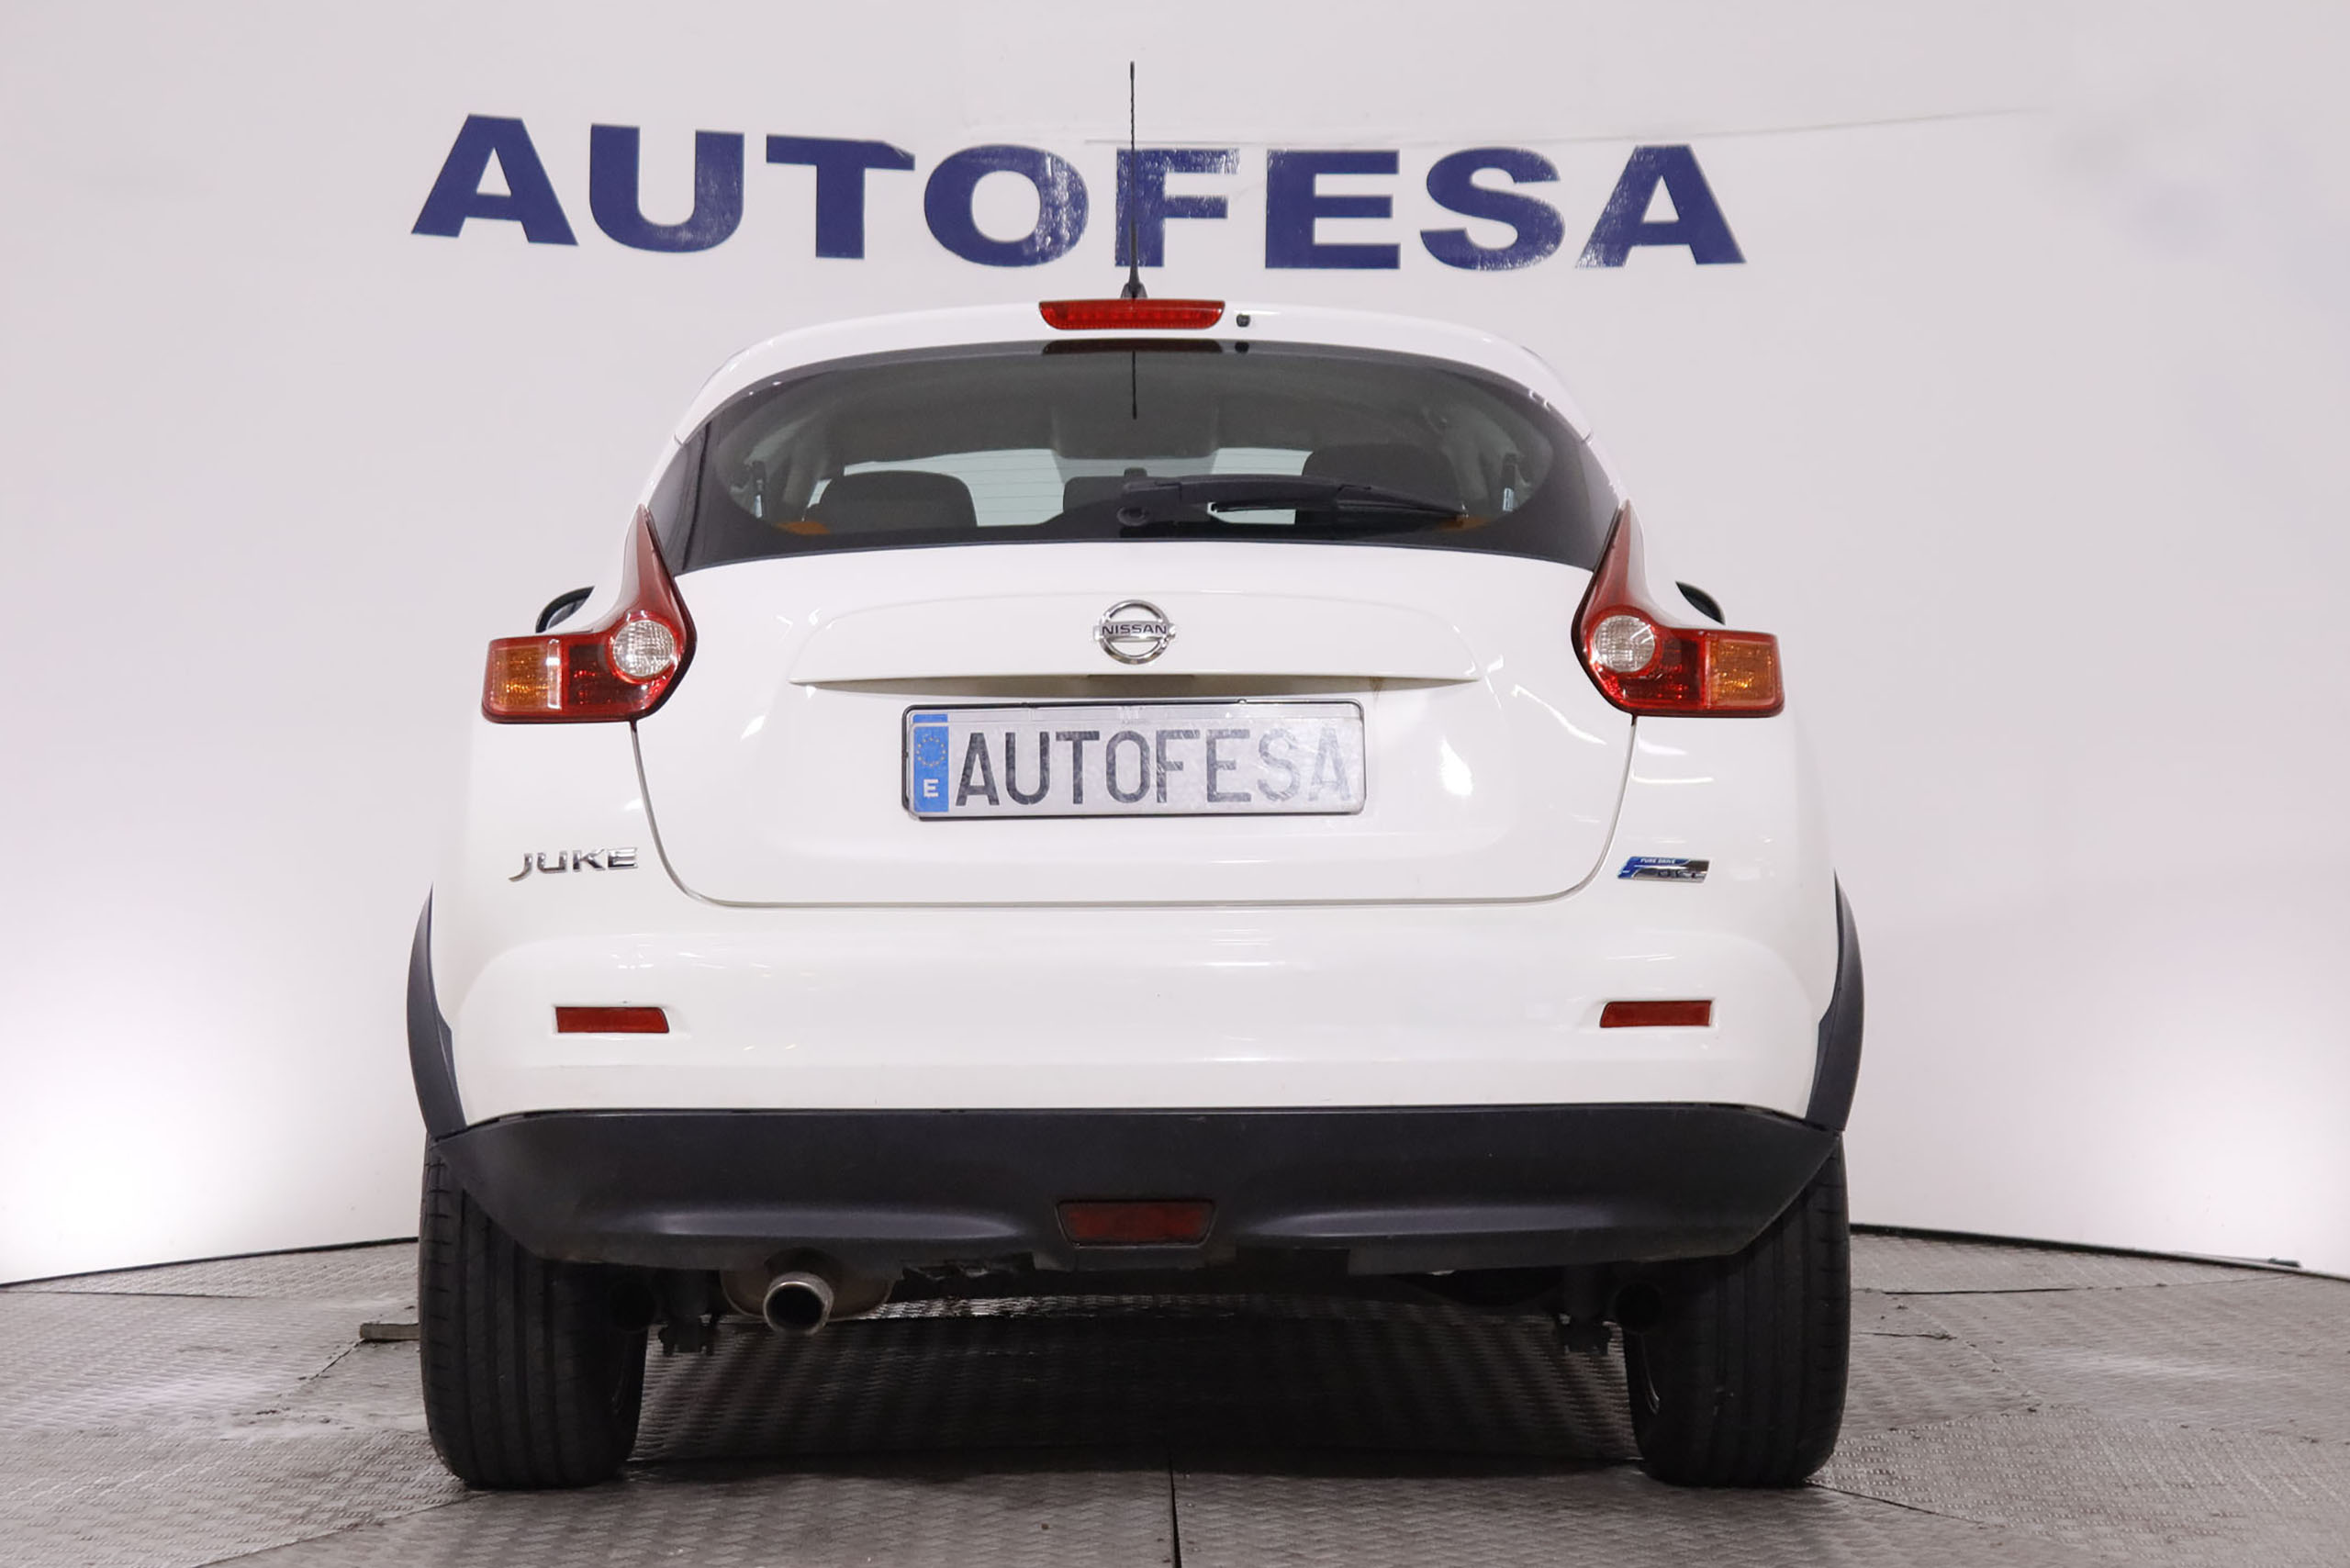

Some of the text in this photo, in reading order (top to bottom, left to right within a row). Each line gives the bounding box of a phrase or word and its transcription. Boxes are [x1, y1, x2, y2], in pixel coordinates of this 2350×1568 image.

[411, 114, 1747, 270] AUTOFESA
[1102, 624, 1167, 634] NISSAN
[956, 729, 1351, 806] AUTOFESA
[923, 778, 939, 798] E
[508, 846, 639, 882] JUKE
